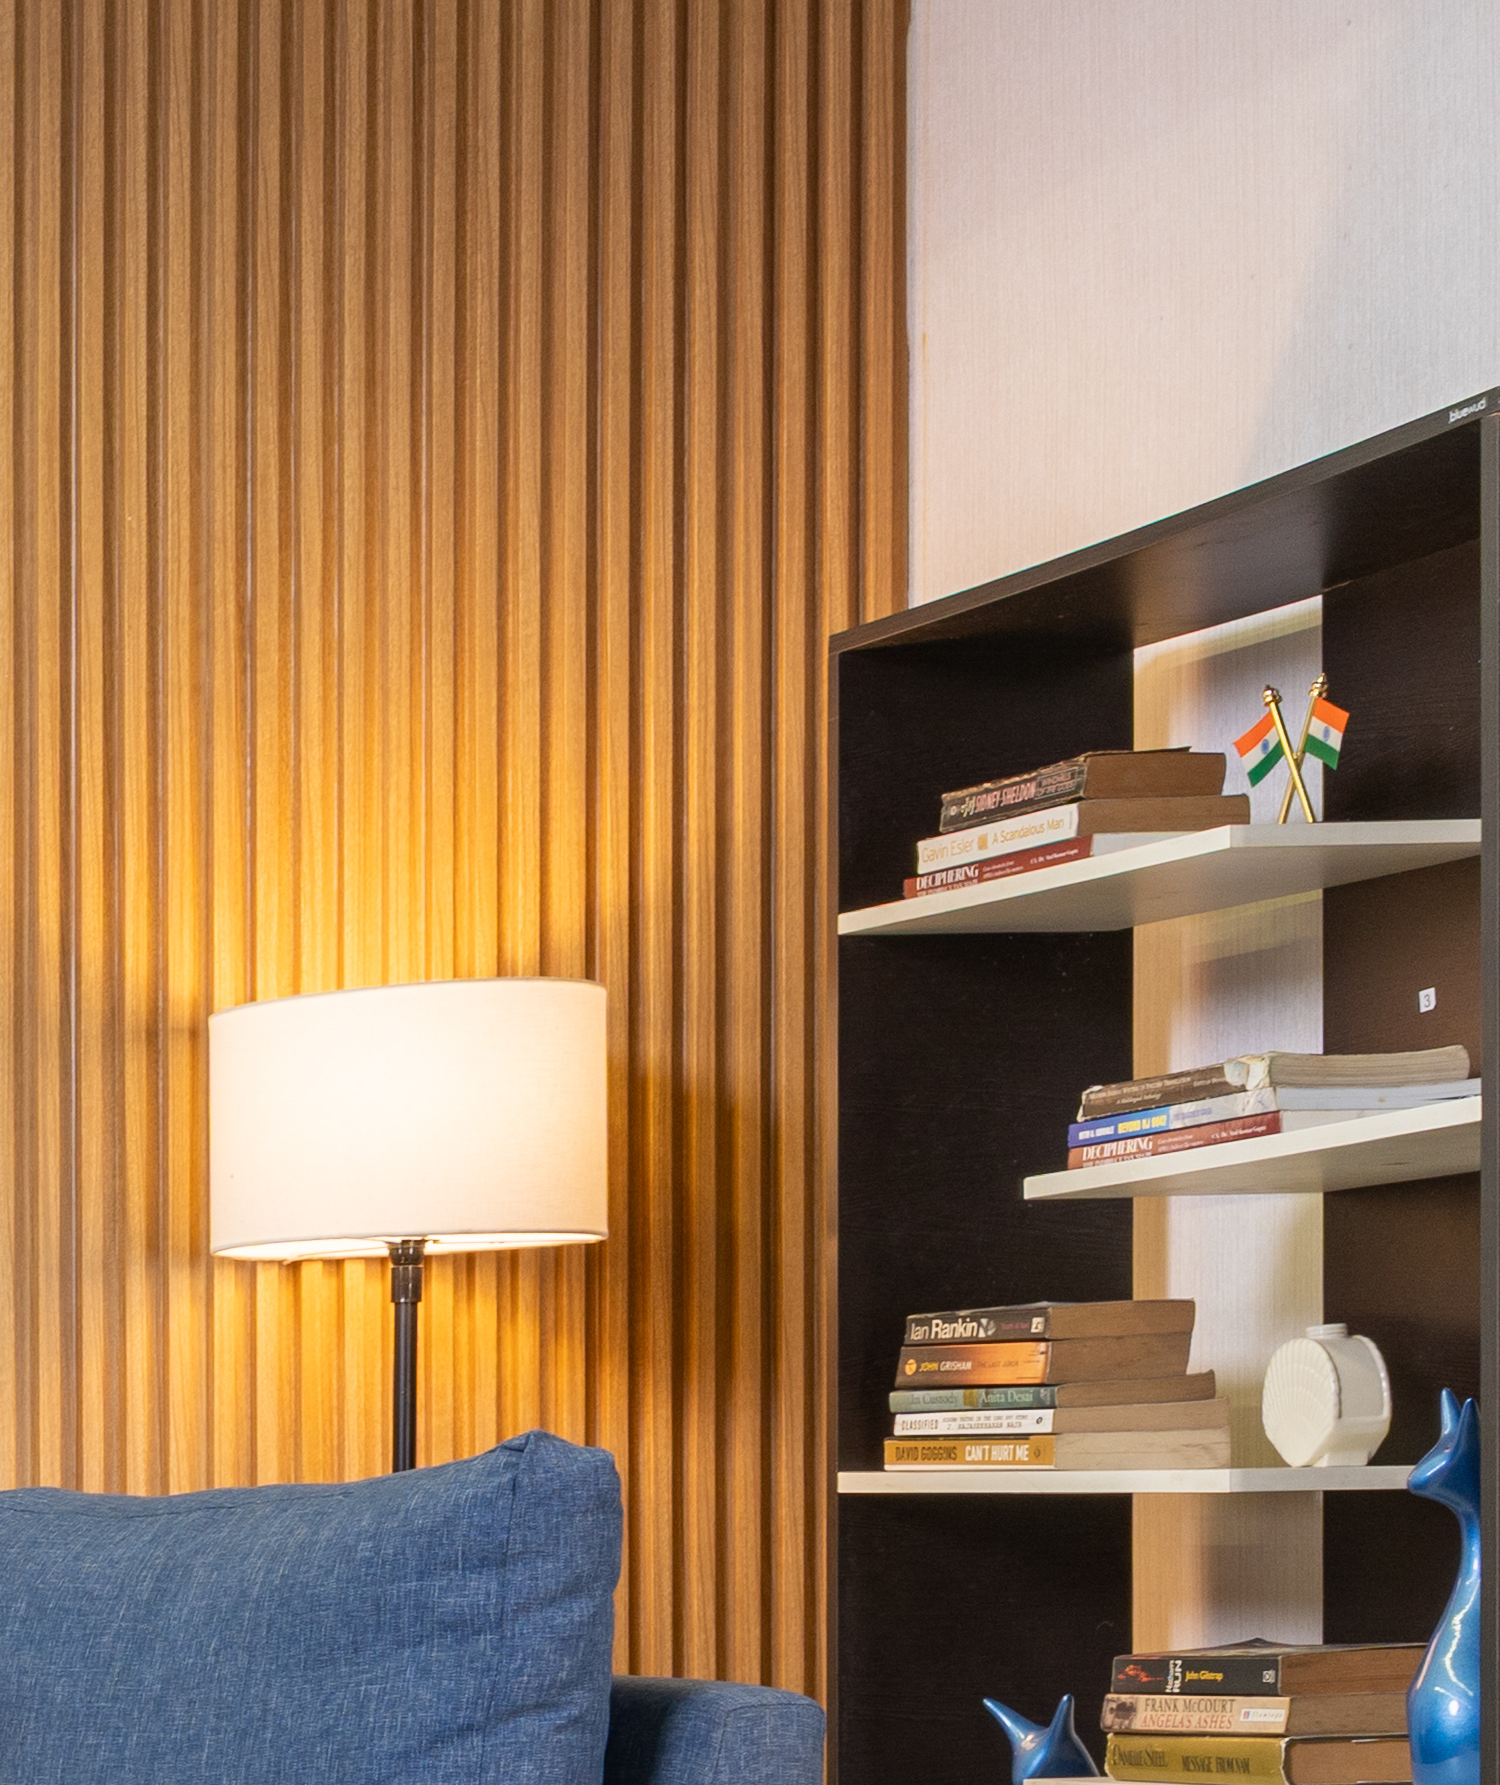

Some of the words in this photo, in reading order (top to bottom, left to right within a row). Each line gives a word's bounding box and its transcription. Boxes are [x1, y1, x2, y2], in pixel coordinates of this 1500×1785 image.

[992, 836, 998, 844] A
[1000, 824, 1045, 844] Scandalous
[1047, 819, 1064, 830] Man
[921, 844, 949, 863] Gavin
[951, 839, 975, 855] Esler
[916, 864, 979, 890] DECIPHERING
[1423, 993, 1431, 1008] 3
[1082, 1136, 1153, 1160] DECIPHERING
[910, 1323, 929, 1340] Ian
[930, 1318, 978, 1339] Rankin
[918, 1362, 939, 1372] JOHN
[940, 1361, 972, 1372] GRISHAM
[911, 1394, 920, 1404] In
[922, 1392, 957, 1407] Custody
[979, 1392, 1005, 1403] Anita
[1007, 1390, 1033, 1403] Desai
[901, 1419, 939, 1431] CLASSIFIED
[895, 1447, 919, 1461] DAVID
[921, 1446, 957, 1461] GOGGINS
[965, 1445, 990, 1461] CAN'T
[991, 1445, 1014, 1461] HURT
[1016, 1444, 1029, 1461] ME
[1172, 1660, 1182, 1693] RUN
[1185, 1671, 1199, 1682] John
[1144, 1698, 1179, 1712] FRANK
[1182, 1699, 1236, 1713] McCOURT
[1140, 1713, 1193, 1729] ANGELA'S
[1194, 1714, 1233, 1729] ASHES
[1182, 1755, 1214, 1773] MESSAGE
